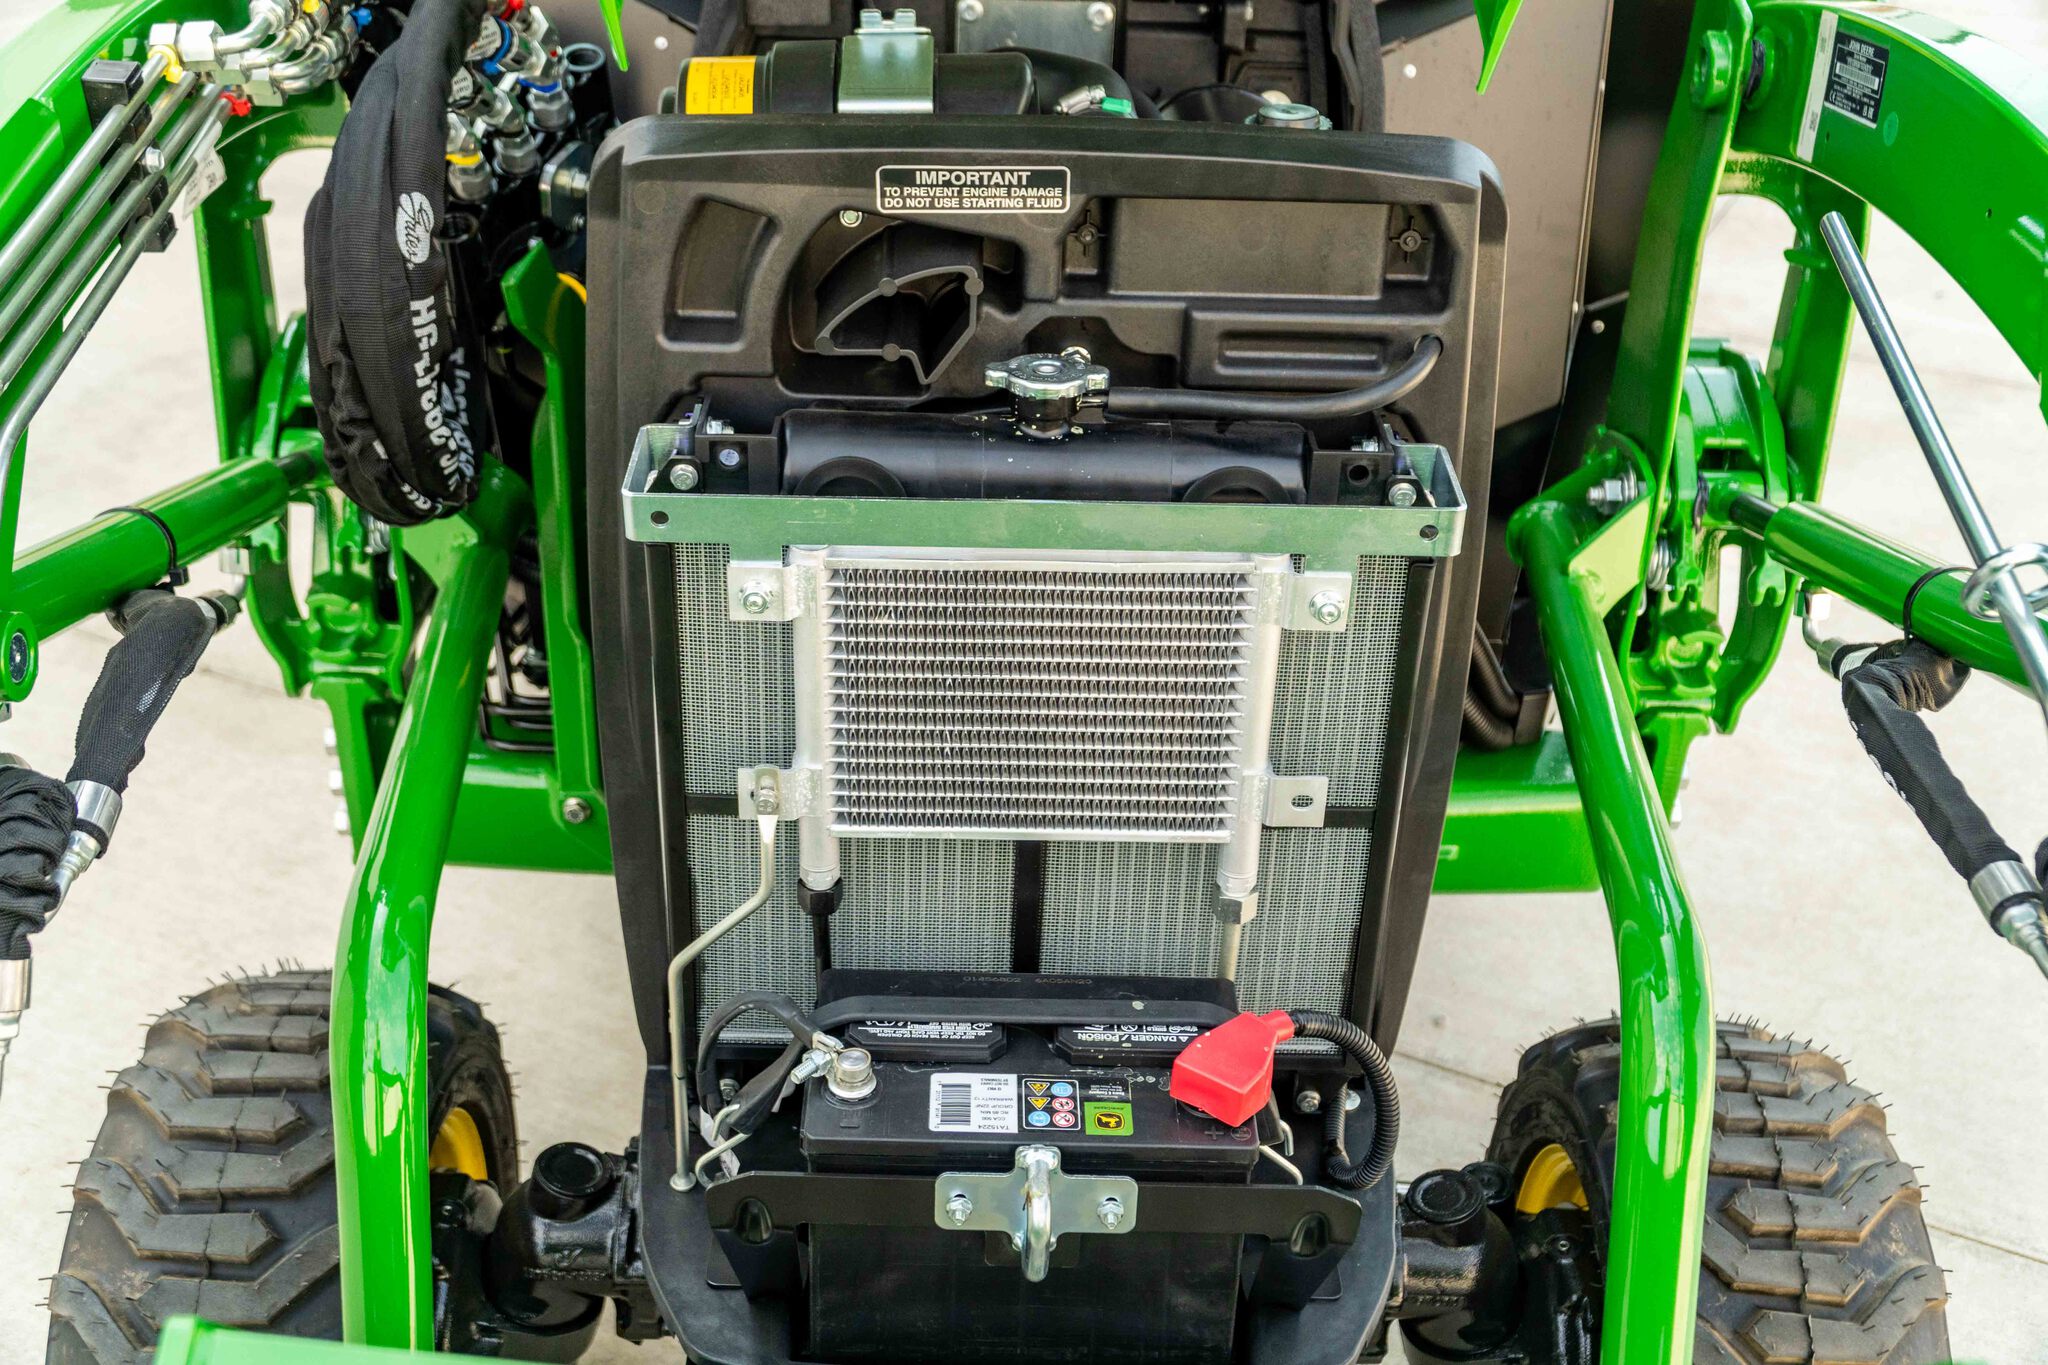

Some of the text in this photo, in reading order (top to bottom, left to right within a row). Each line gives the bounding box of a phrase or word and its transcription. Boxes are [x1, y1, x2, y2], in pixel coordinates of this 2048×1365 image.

[915, 170, 1031, 186] IMPORTANT
[884, 187, 1063, 197] TO PREVENT ENGINE DAMAGE
[884, 198, 1063, 208] DO NOT USE STARTING FLUID
[1078, 1033, 1119, 1042] POISON
[1131, 1034, 1177, 1042] DANGER
